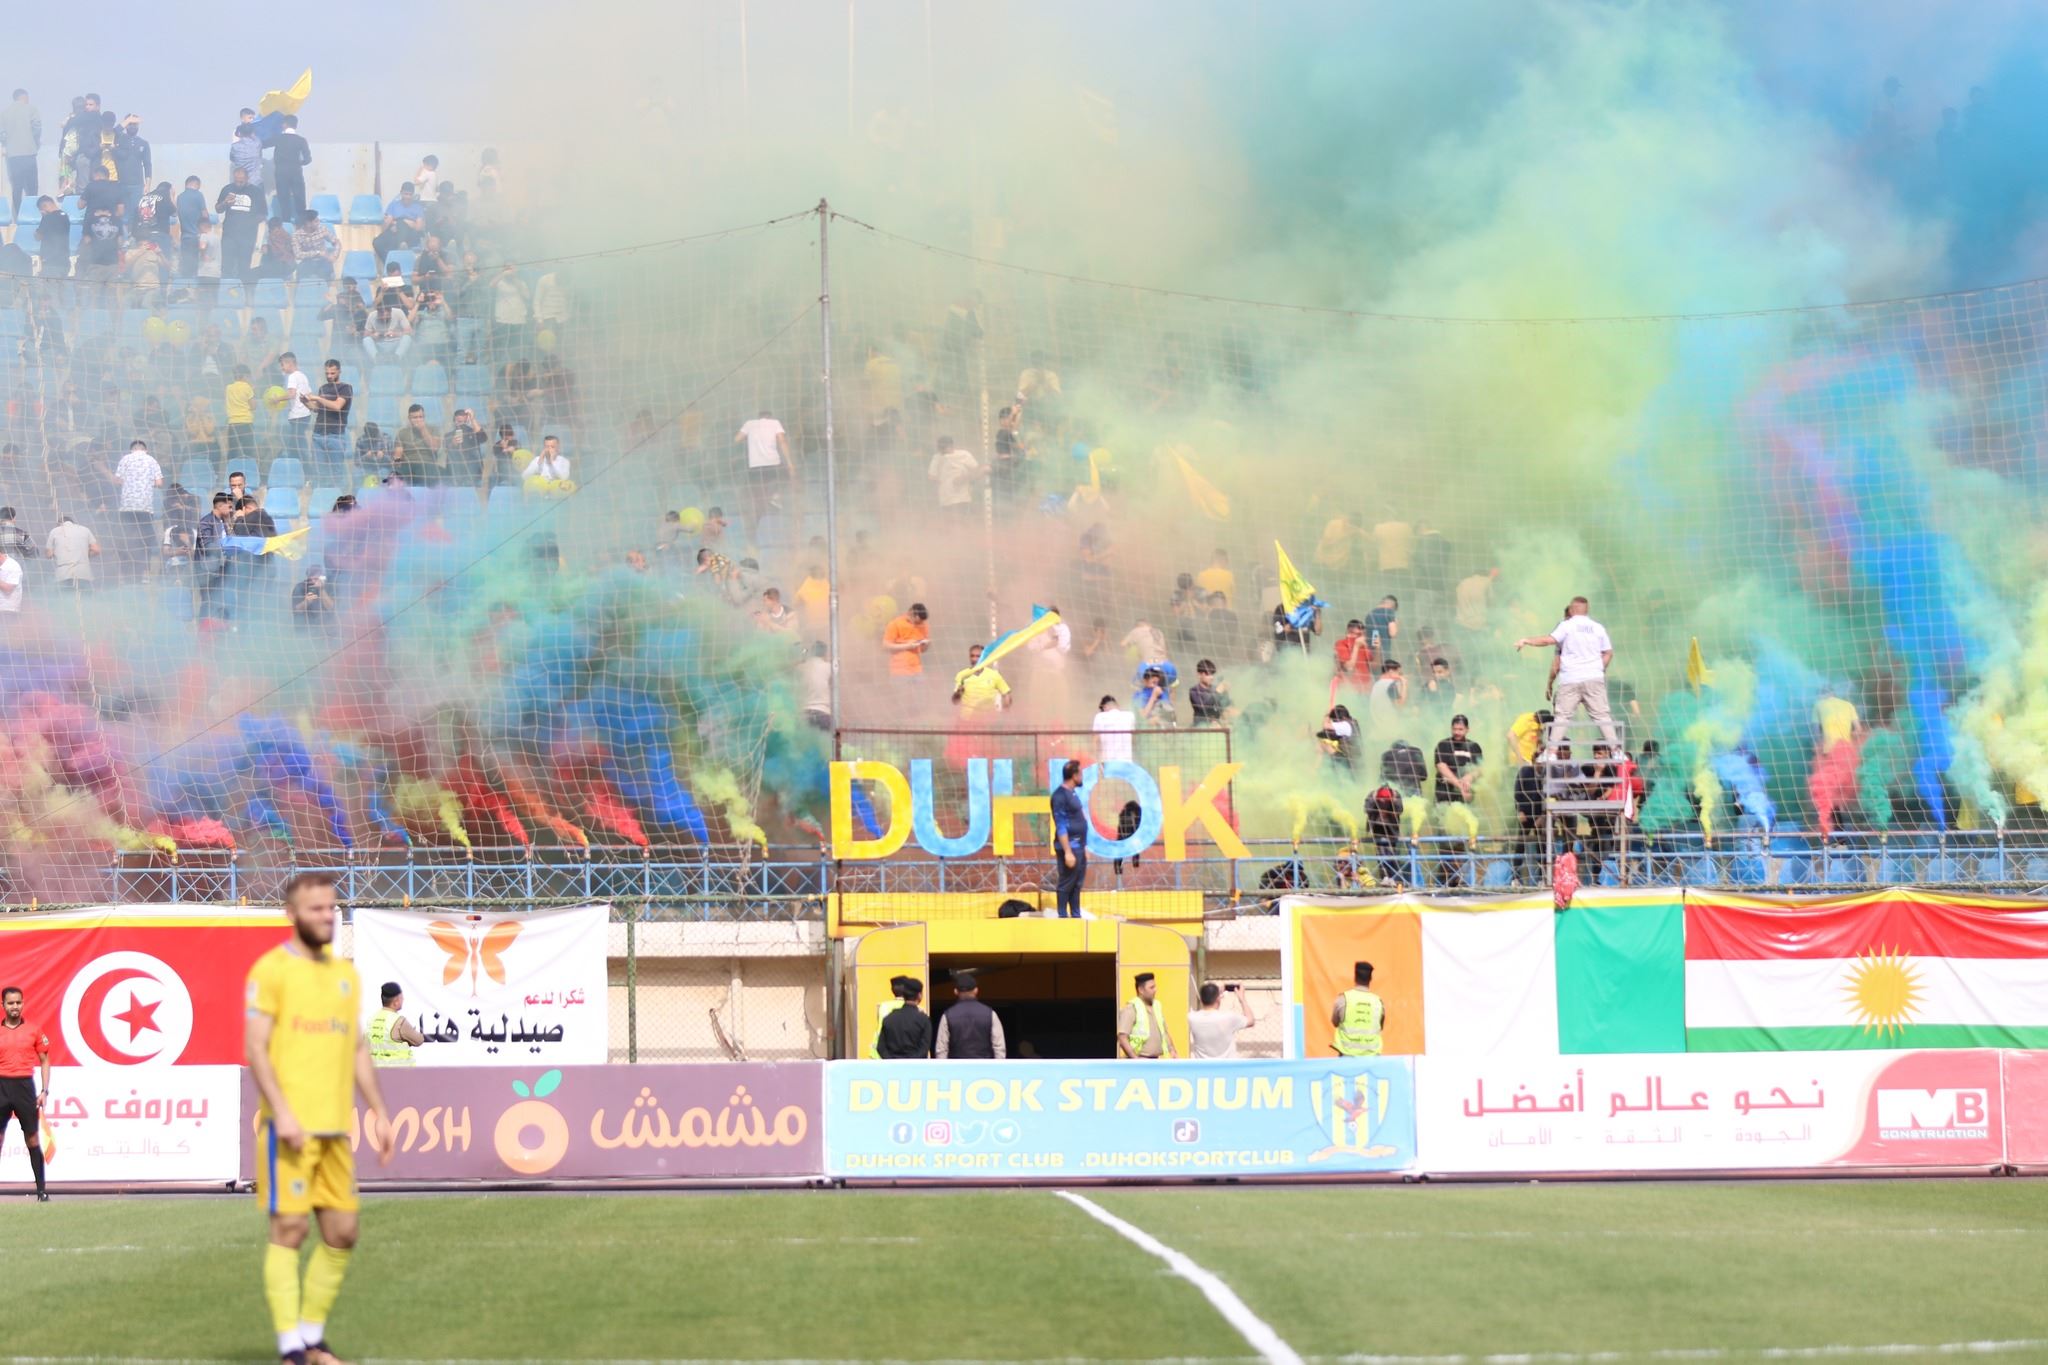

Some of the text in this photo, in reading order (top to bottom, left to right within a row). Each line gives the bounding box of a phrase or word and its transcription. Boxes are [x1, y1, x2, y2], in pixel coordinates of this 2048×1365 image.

[829, 758, 1252, 862] DUHOK
[523, 987, 585, 1010] شكرا لدعم
[411, 1011, 460, 1043] هنا
[470, 1008, 565, 1055] صيدلية
[847, 1076, 1295, 1113] DUHOK STADIUM
[1463, 1068, 1825, 1118] نحو عالم أفضل
[590, 1084, 809, 1150] مشمش
[1605, 1125, 1683, 1144] الثقة
[1734, 1122, 1812, 1145] الجودة
[1880, 1128, 1987, 1140] CONSTRUCTION
[845, 1151, 1065, 1169] DUHOK SPORT CLUB
